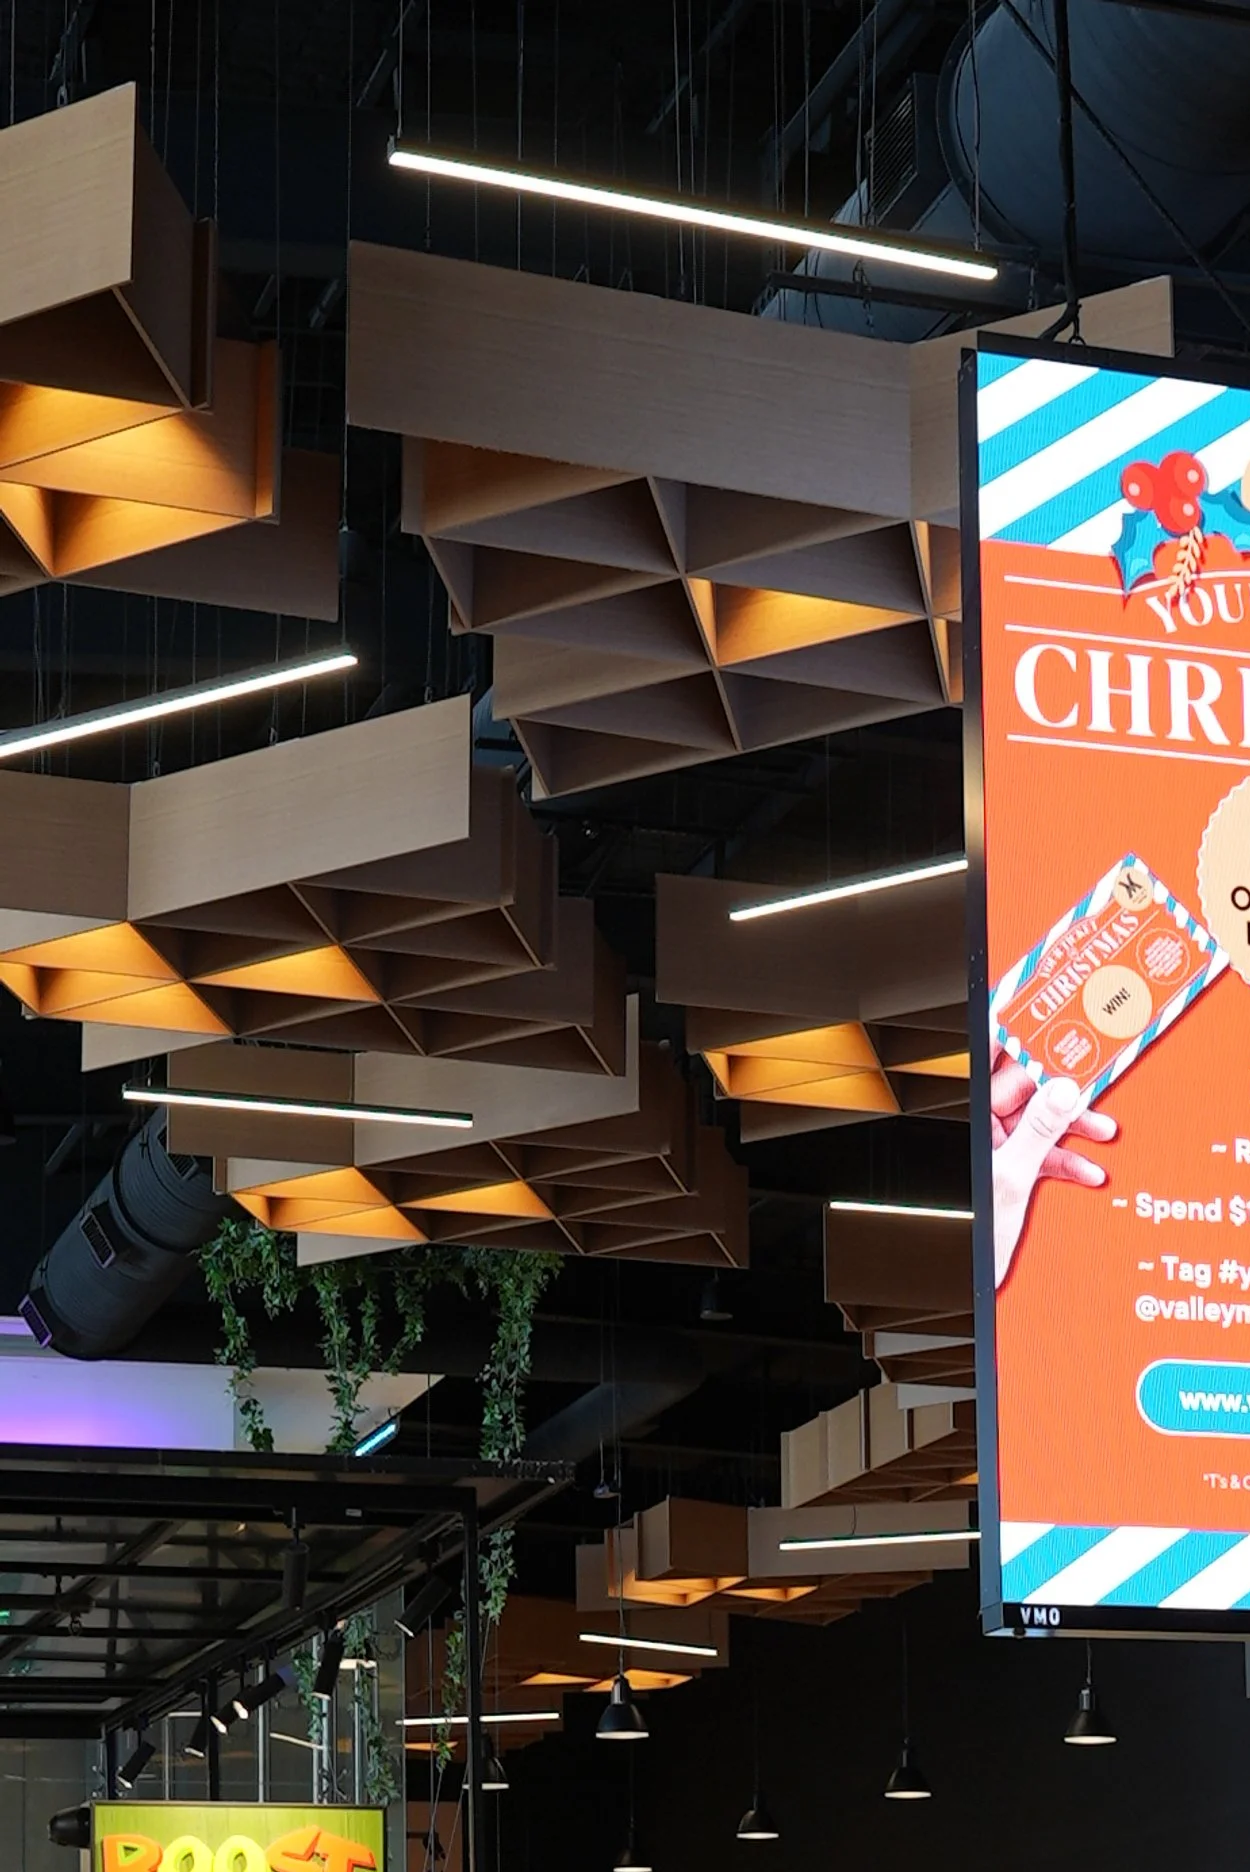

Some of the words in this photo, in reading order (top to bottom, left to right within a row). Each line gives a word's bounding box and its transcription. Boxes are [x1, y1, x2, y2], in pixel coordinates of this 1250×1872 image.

[1029, 910, 1140, 1022] CHRISTMAS
[1102, 987, 1132, 1016] WIN!
[1135, 1193, 1222, 1224] Spend
[1161, 1255, 1213, 1288] Tag
[1020, 1606, 1060, 1626] VMO
